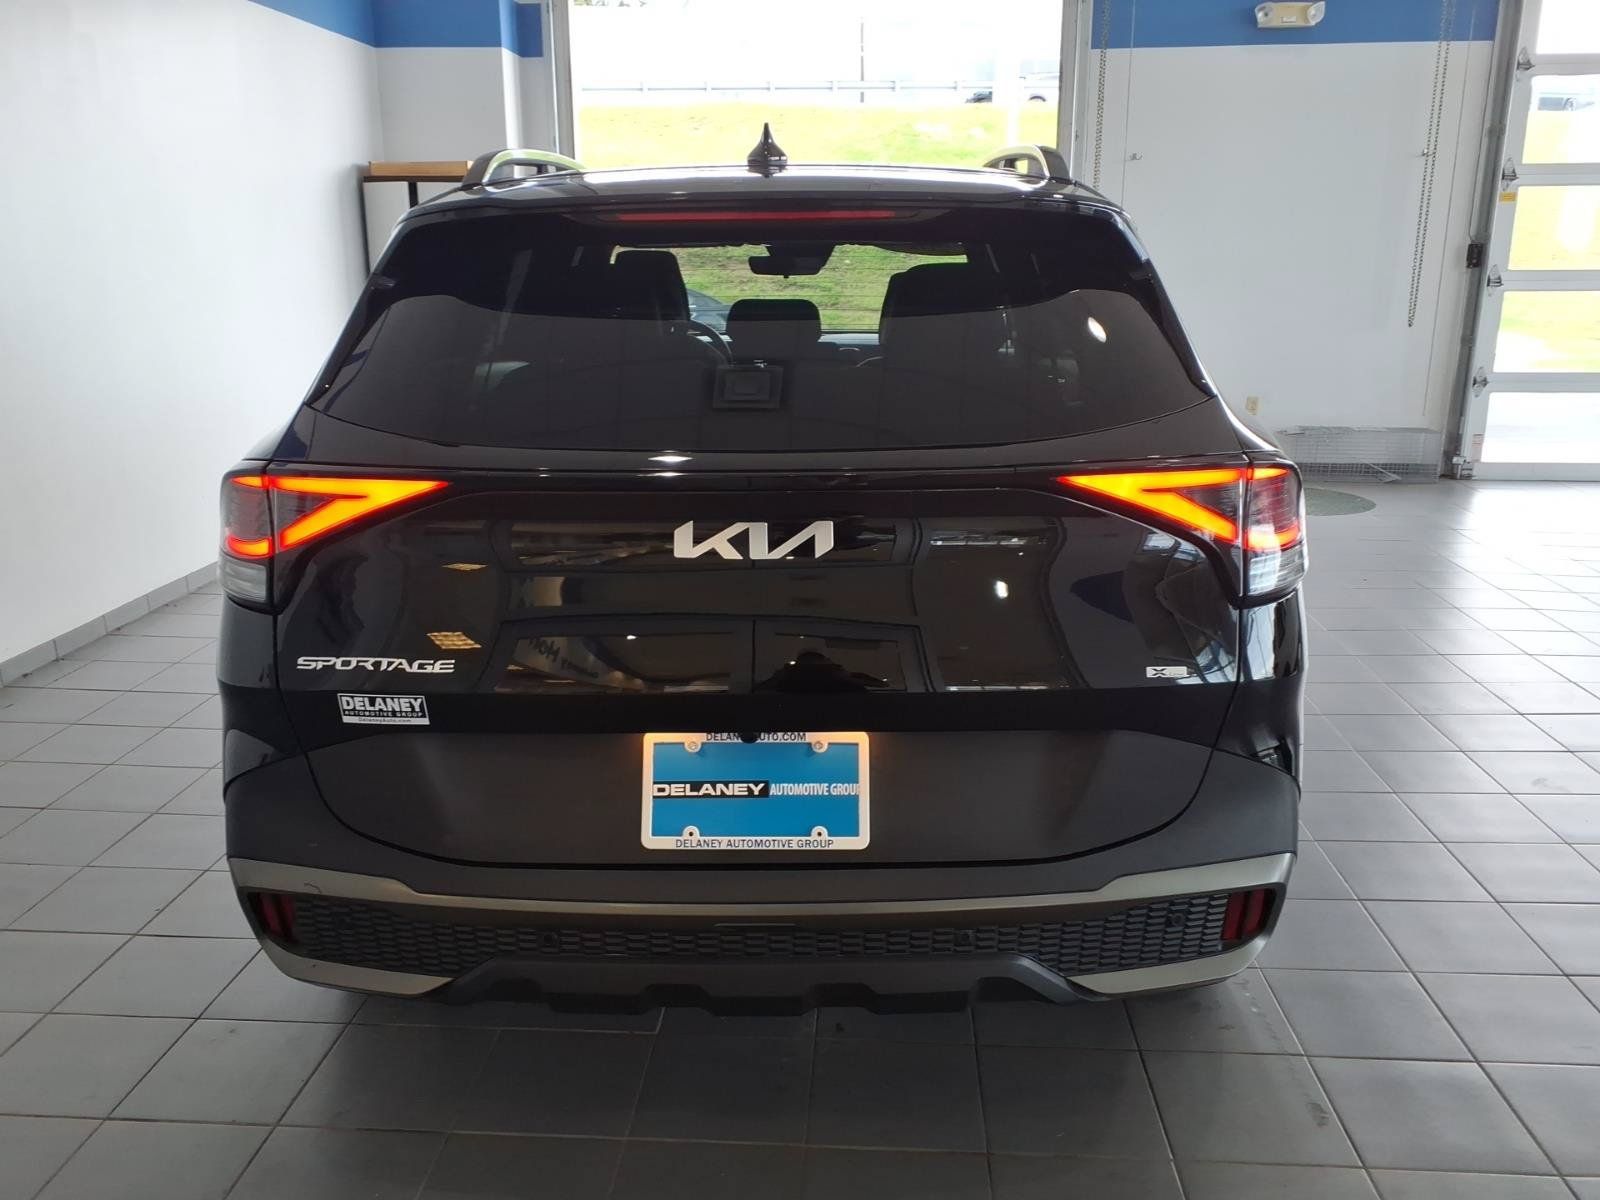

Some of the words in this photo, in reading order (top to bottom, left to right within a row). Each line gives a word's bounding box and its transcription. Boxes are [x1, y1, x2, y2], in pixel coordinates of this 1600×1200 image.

[674, 520, 834, 560] KIA
[297, 656, 455, 673] SPORTAGE
[341, 696, 422, 712] DELANEY
[706, 732, 807, 742] DELANUTO.COM
[653, 783, 766, 797] DELANEY
[769, 783, 829, 796] AUTOMOTIVE
[675, 839, 722, 849] DELANEY
[726, 839, 794, 849] AUTOMOTIVE
[796, 839, 835, 849] GROUP
